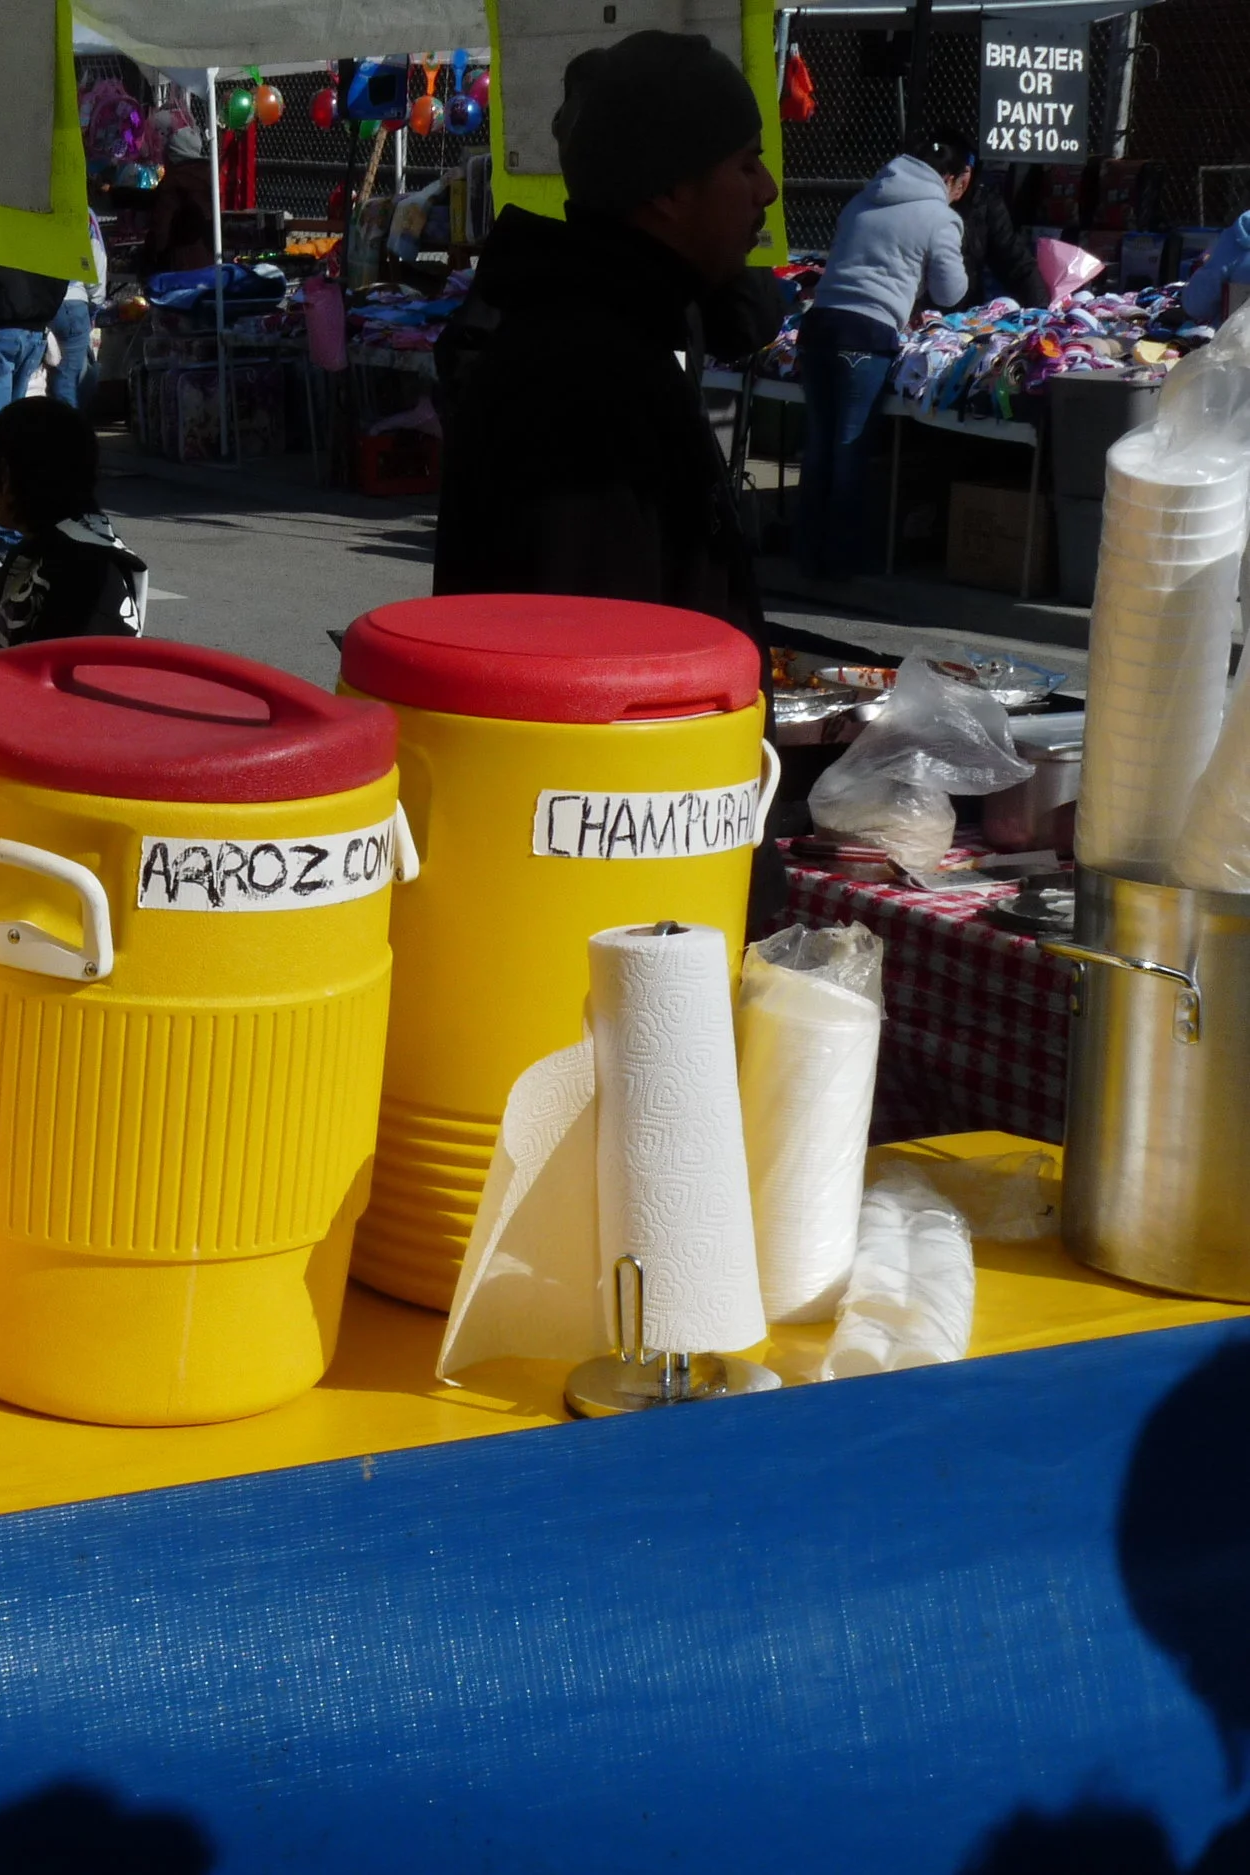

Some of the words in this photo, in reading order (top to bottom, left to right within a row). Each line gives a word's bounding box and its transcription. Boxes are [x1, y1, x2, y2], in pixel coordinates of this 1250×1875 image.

[985, 42, 1084, 73] BRAZIER
[1019, 70, 1053, 95] OR
[996, 98, 1075, 126] PANTY
